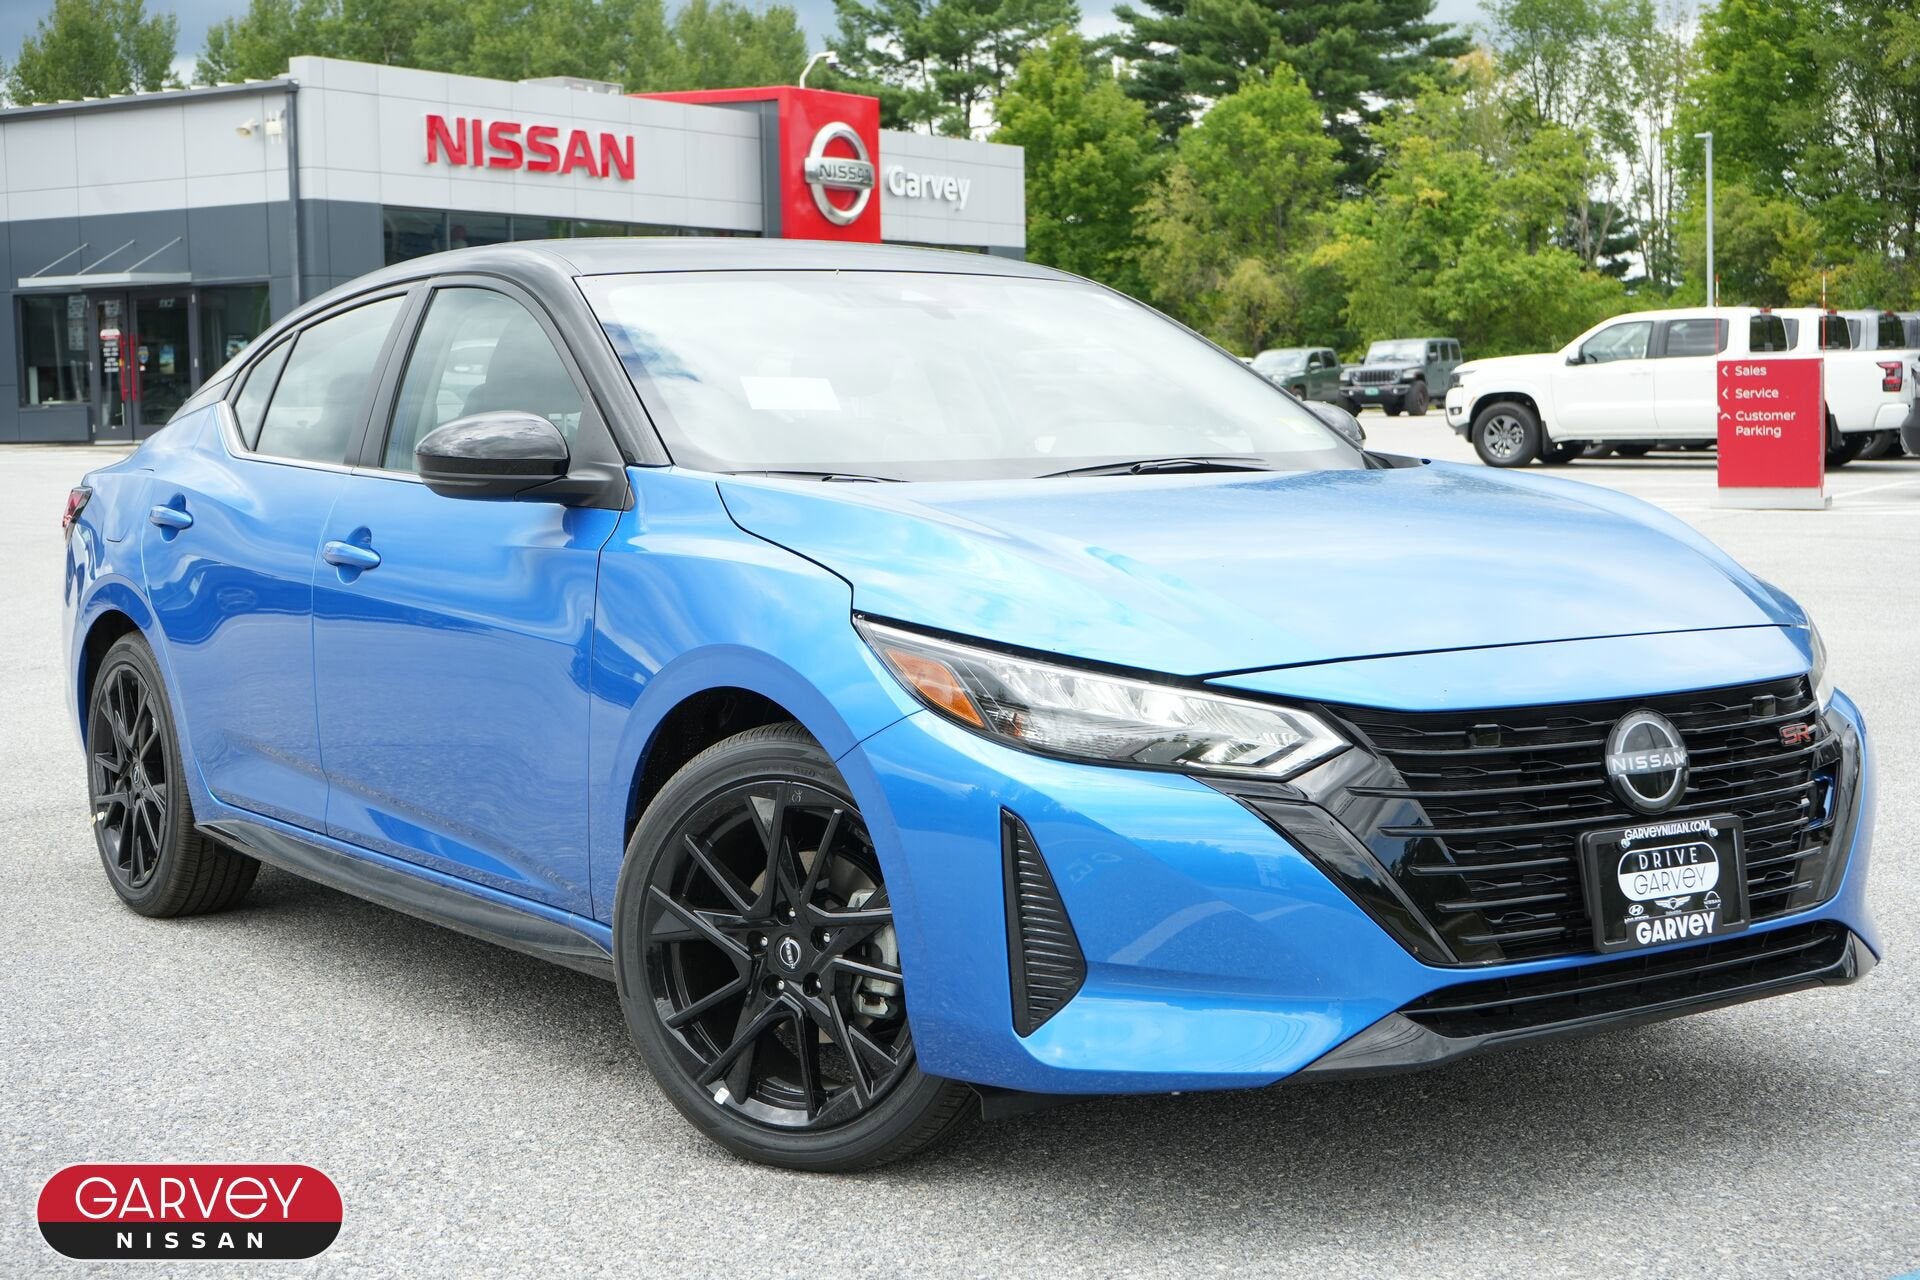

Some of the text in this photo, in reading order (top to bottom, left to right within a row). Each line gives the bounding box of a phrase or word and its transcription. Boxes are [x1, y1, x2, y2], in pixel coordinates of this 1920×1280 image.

[426, 114, 635, 180] NISSAN
[818, 163, 874, 184] NISSAN
[887, 164, 971, 210] Garvey
[1735, 365, 1767, 376] Sales
[1735, 387, 1779, 399] Service
[1735, 411, 1796, 421] Customer
[1736, 425, 1781, 438] Parking
[1781, 724, 1810, 746] SR
[1612, 750, 1686, 772] NISSAN
[1639, 847, 1698, 870] DRIVE
